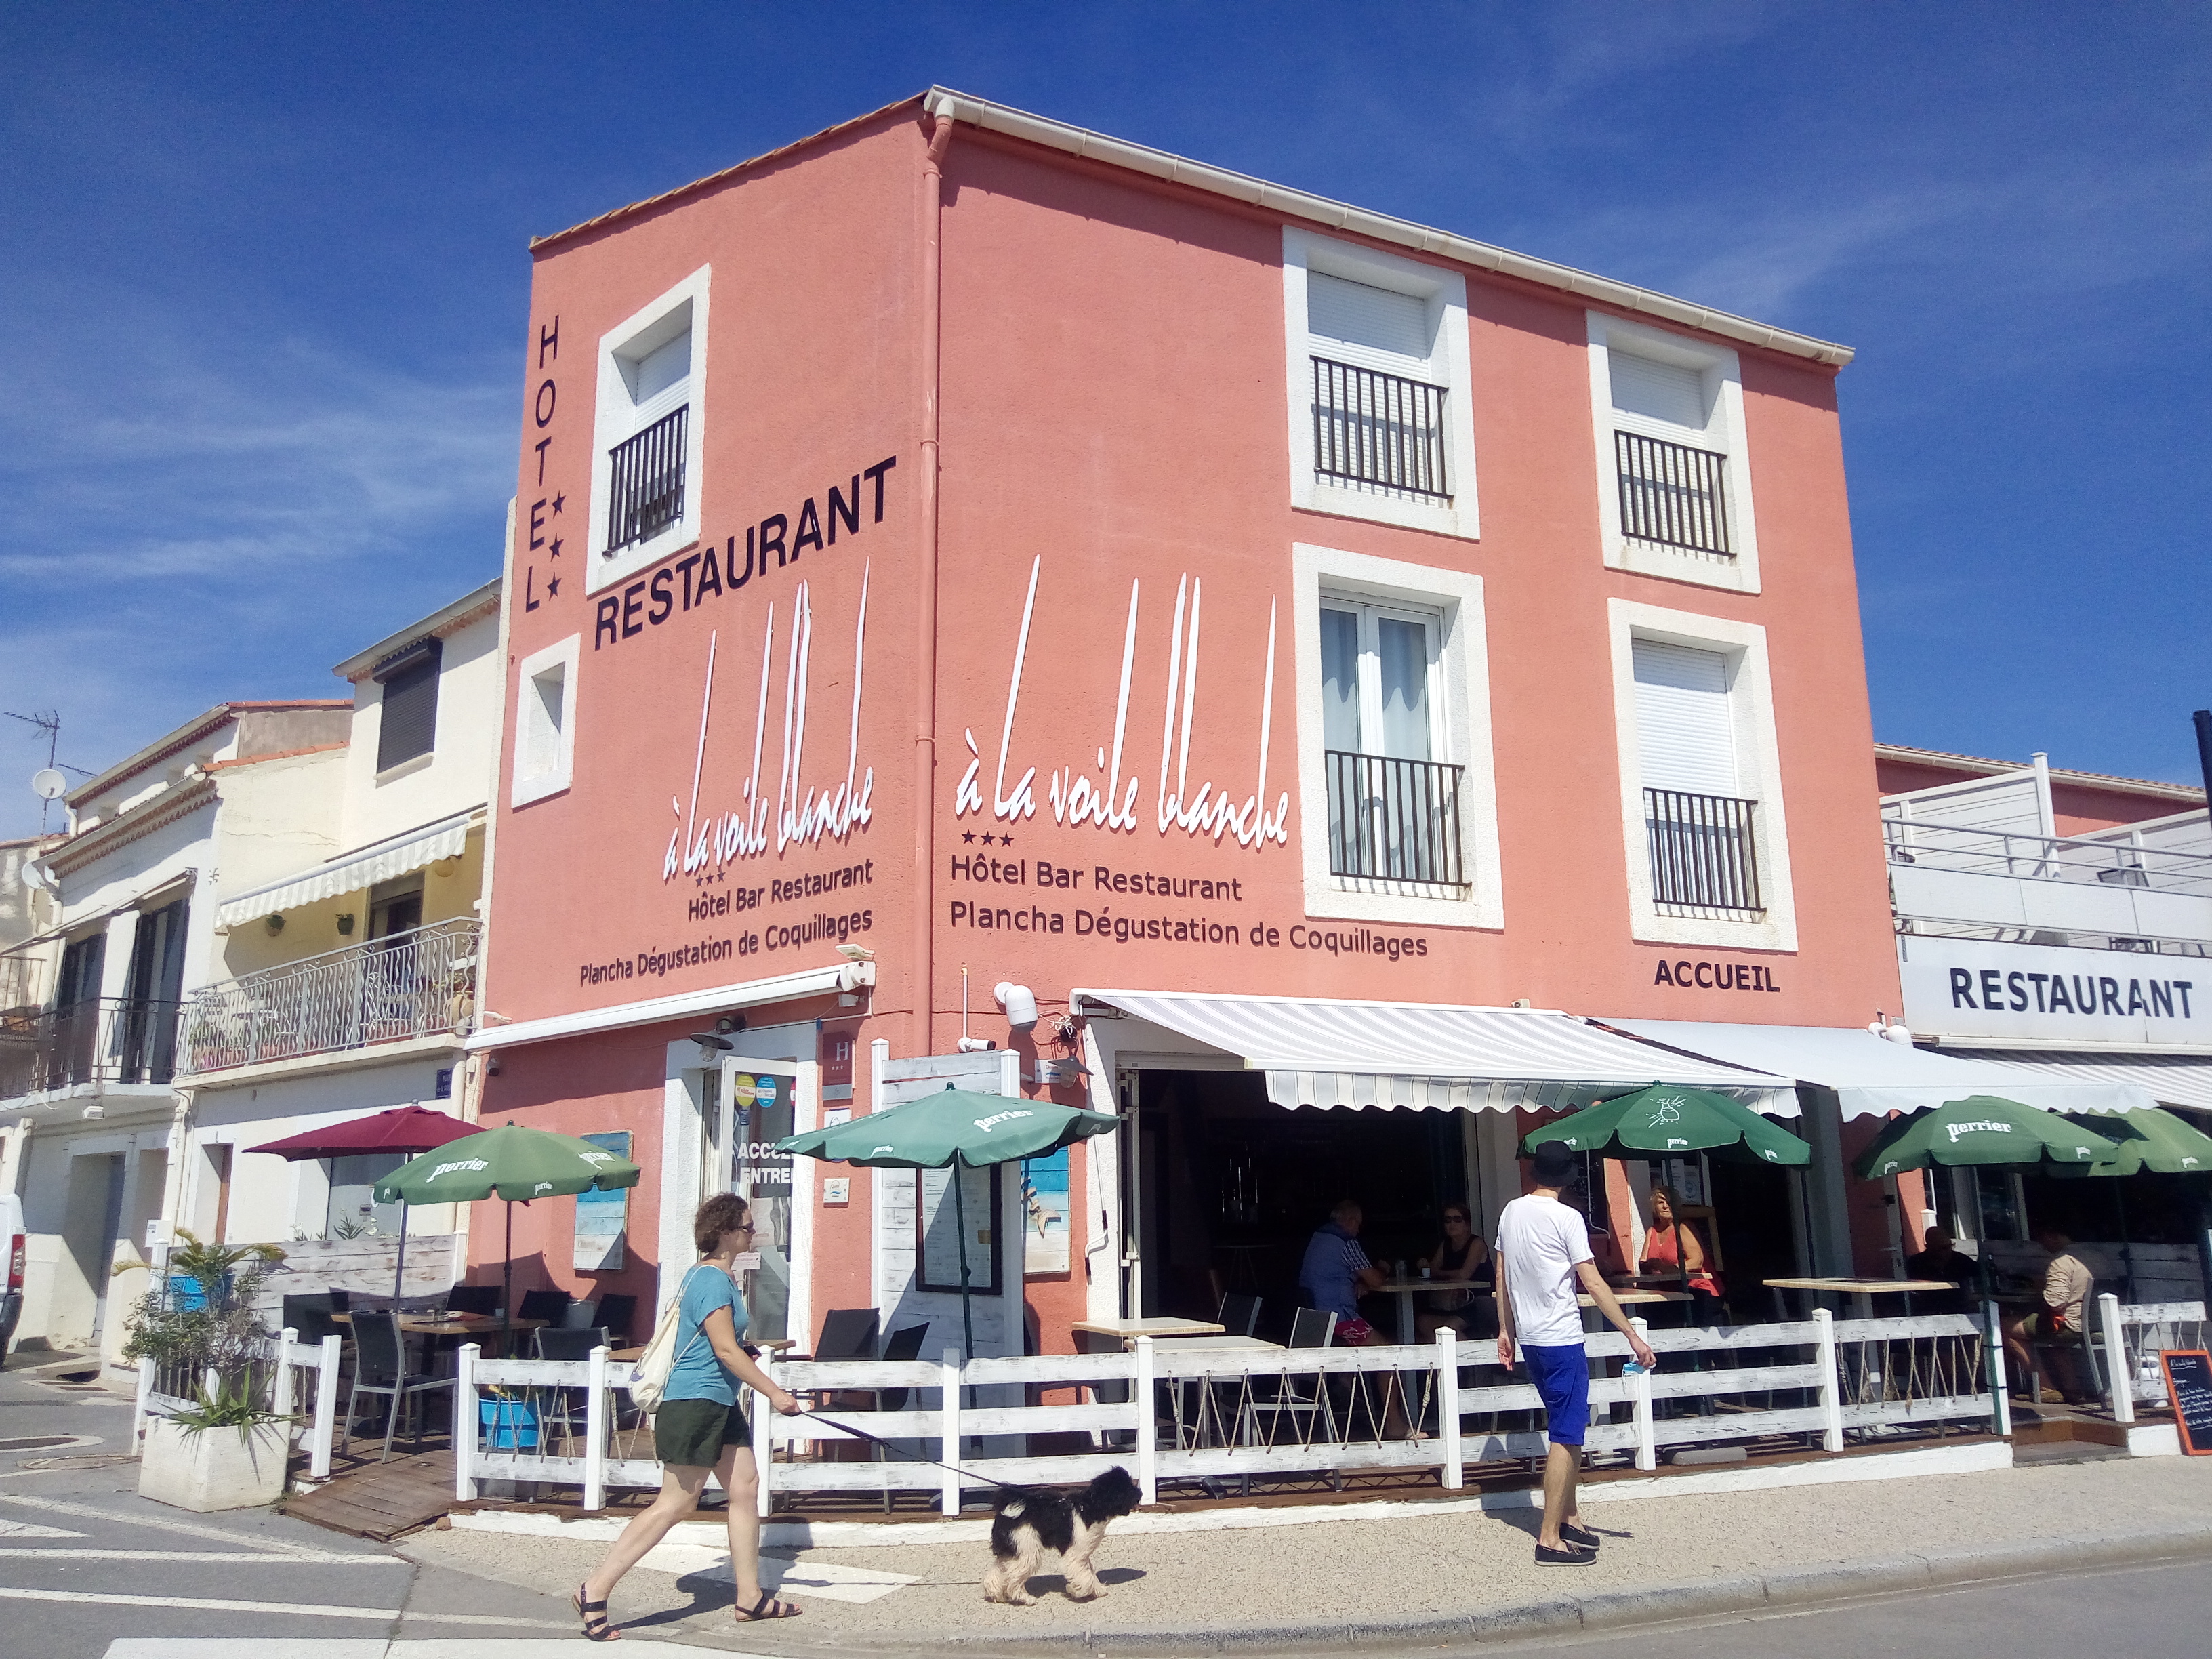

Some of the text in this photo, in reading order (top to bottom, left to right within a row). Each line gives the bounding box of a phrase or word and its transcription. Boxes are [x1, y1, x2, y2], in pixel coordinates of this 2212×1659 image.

[525, 314, 560, 613] HOTEL
[595, 455, 897, 651] RESTAURANT
[663, 795, 680, 881] à
[714, 601, 773, 867] voile
[777, 556, 873, 853] blanche
[955, 727, 983, 815] à
[1049, 577, 1139, 830] voile
[1158, 571, 1288, 849] blanche
[688, 858, 874, 922] Hôtel Bar Restaurant
[951, 853, 1242, 901] Hôtel Bar Restaurant
[580, 909, 873, 987] Plancha Dégustation de Coquillages
[950, 901, 1429, 962] Plancha Dégustation de Coquillages
[1654, 960, 1781, 992] ACCUEIL
[1950, 967, 2193, 1019] RESTAURANT
[836, 1041, 849, 1061] H
[972, 1109, 1035, 1133] perrier
[1667, 1137, 1689, 1149] perrier
[1946, 1120, 2013, 1143] perrier
[426, 1157, 489, 1183] perrier
